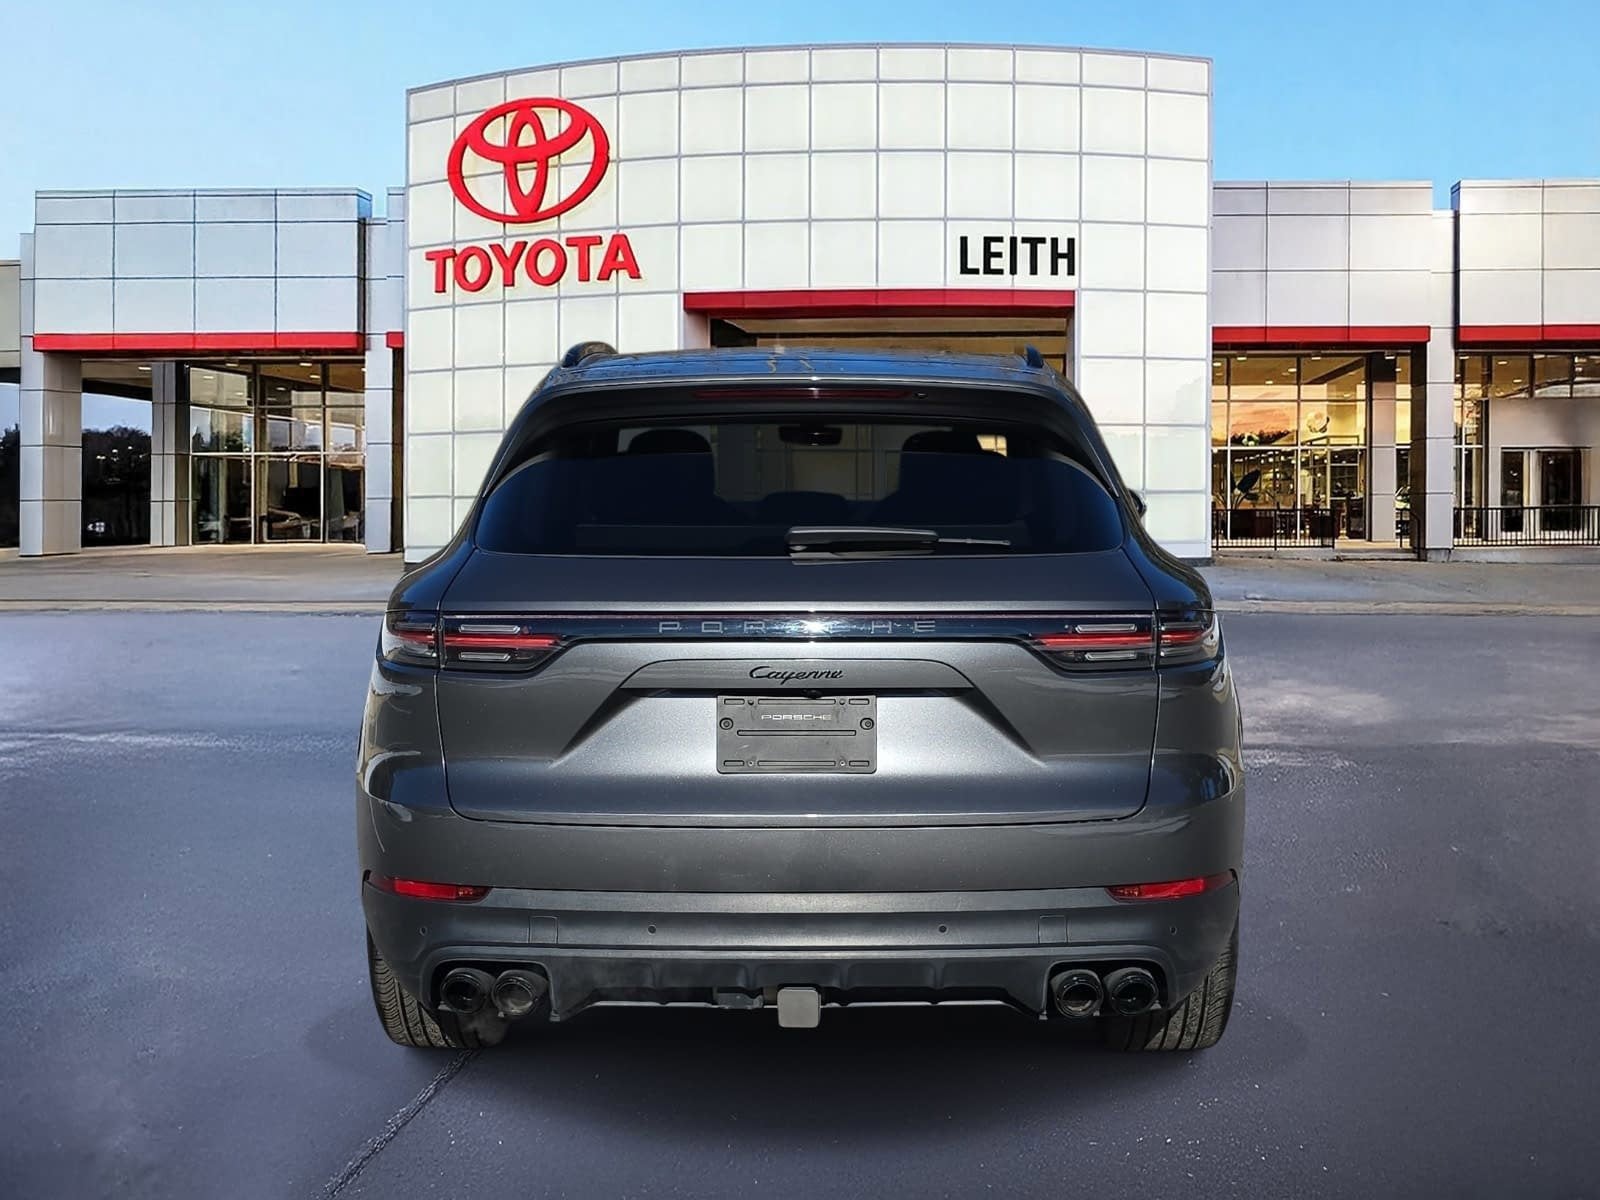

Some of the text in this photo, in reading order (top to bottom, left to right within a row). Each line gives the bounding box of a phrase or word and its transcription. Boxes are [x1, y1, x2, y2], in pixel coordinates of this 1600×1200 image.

[425, 233, 641, 294] TOYOTA
[959, 236, 1076, 276] LEITH
[658, 620, 936, 634] PORCHE
